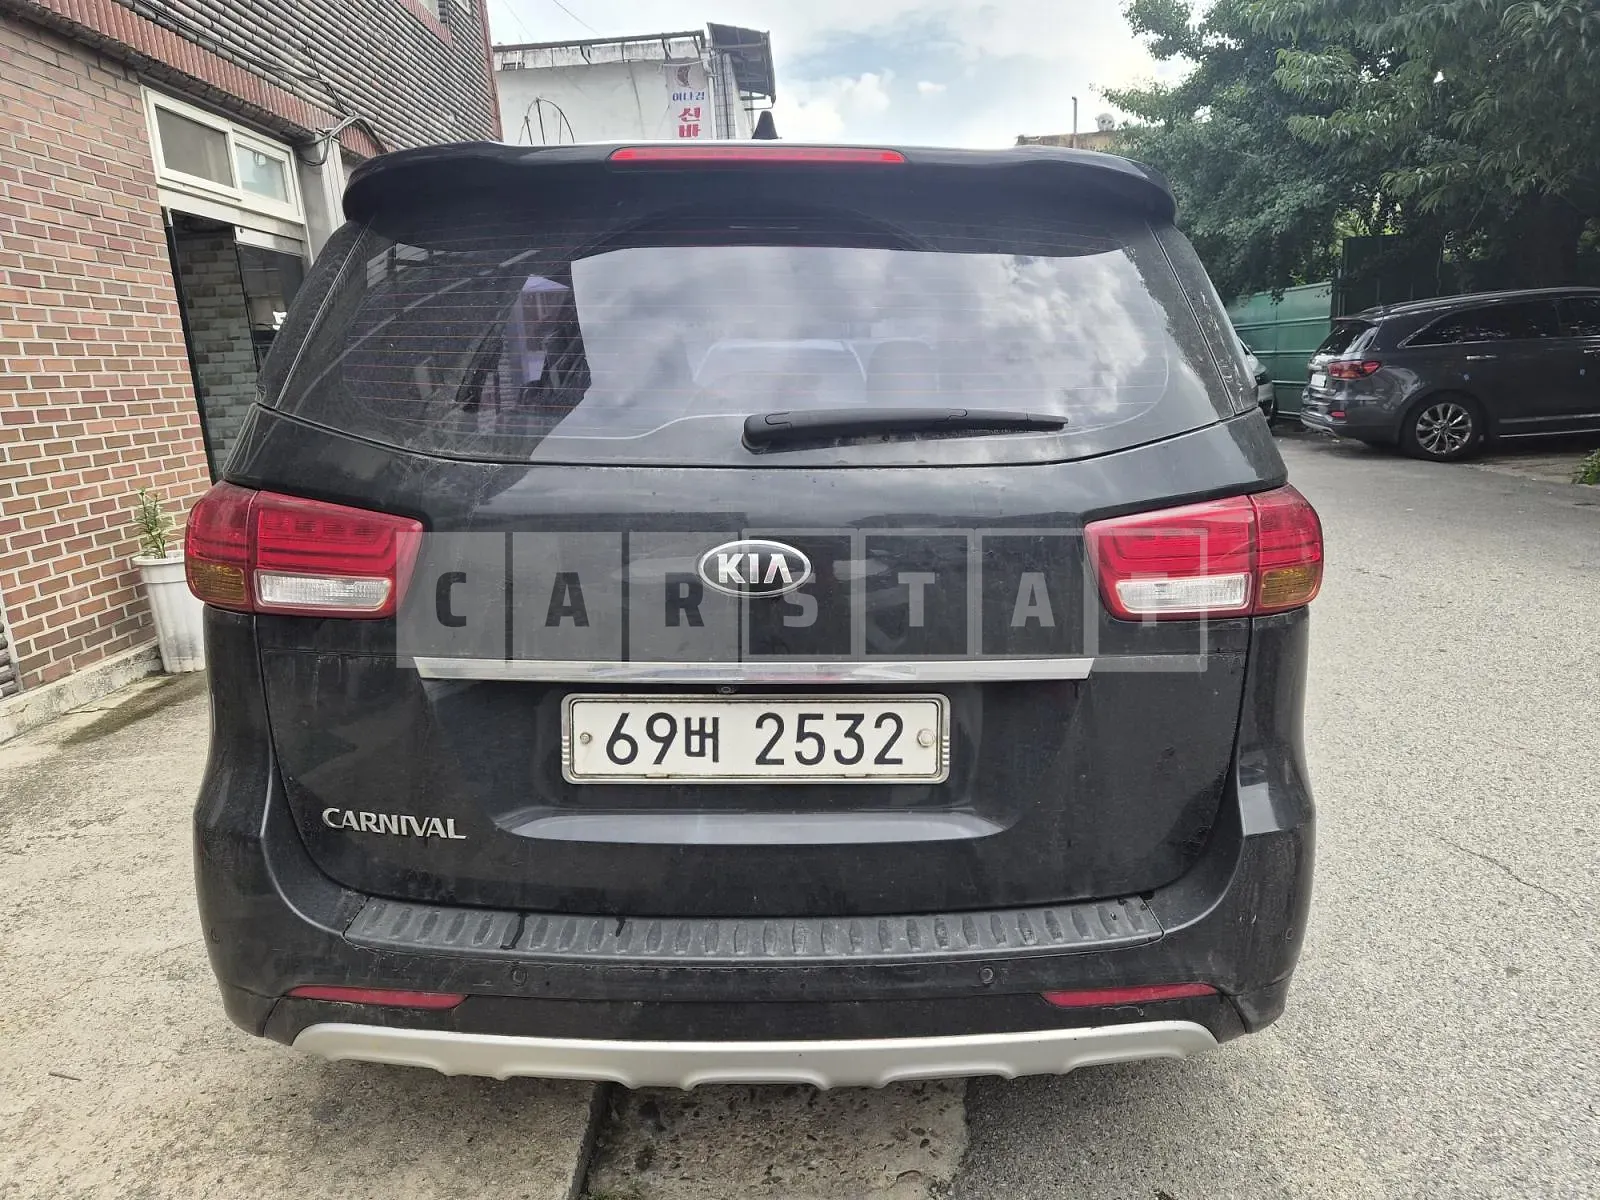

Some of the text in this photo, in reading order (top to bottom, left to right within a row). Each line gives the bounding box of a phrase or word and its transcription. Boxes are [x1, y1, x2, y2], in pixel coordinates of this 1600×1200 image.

[717, 553, 793, 584] KIA
[606, 711, 904, 765] 69버 2532
[322, 807, 467, 840] CARNIVAL
